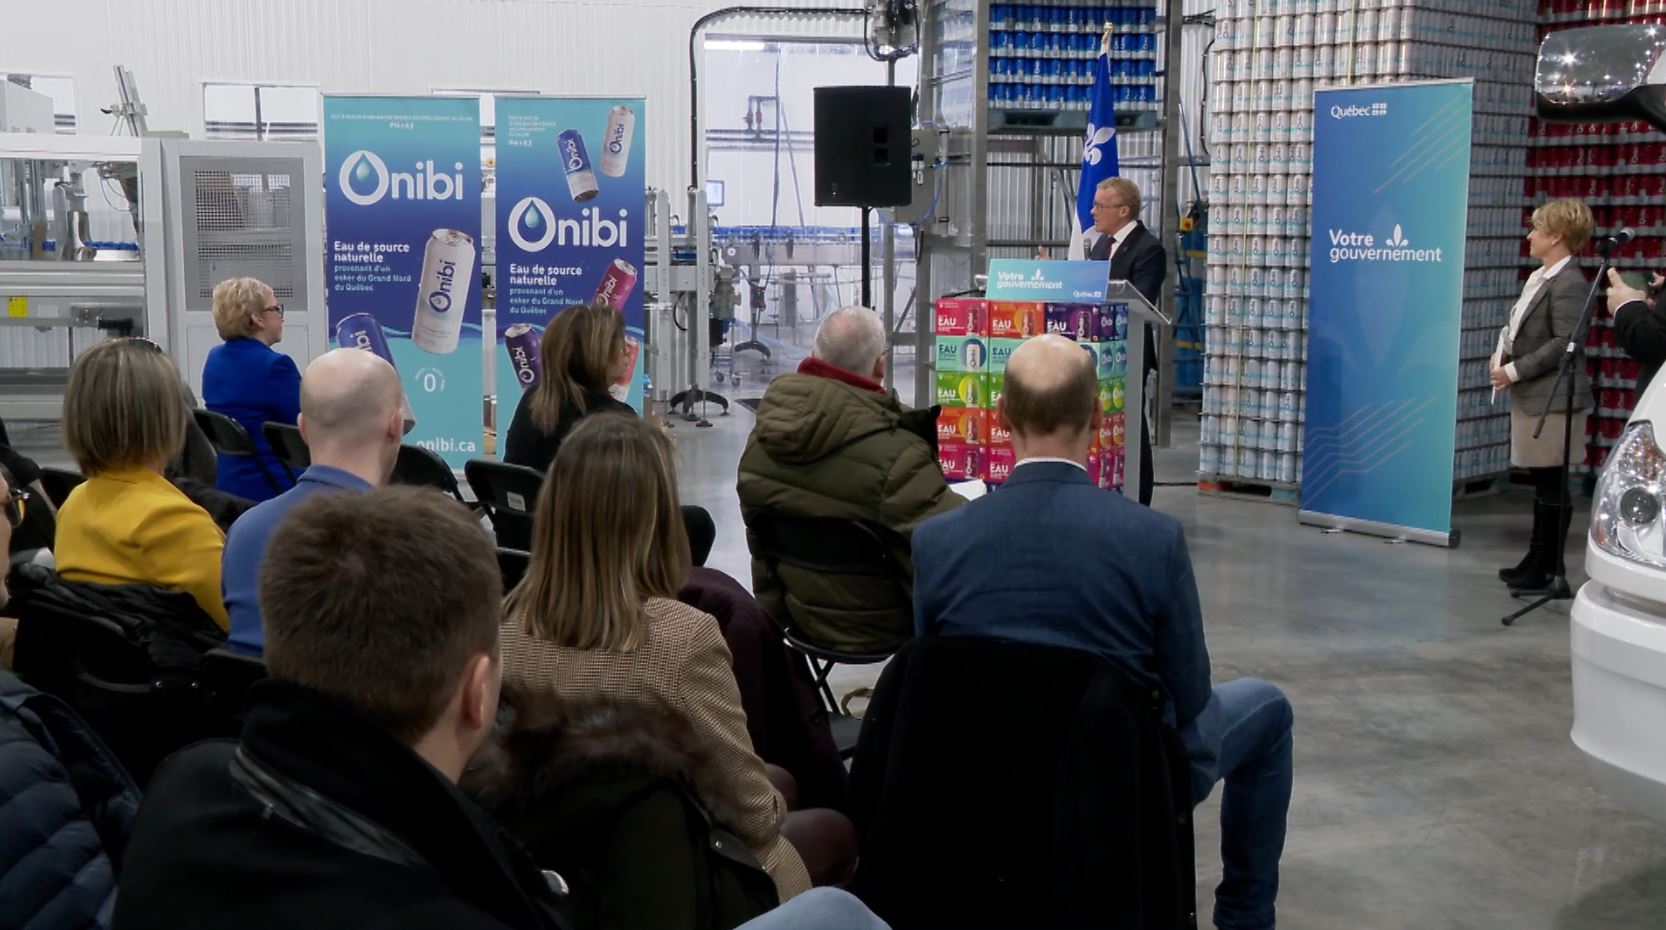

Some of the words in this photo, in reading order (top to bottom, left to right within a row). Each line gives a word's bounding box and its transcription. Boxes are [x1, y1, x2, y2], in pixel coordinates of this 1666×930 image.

[1331, 103, 1371, 119] Québec
[608, 123, 625, 154] Onibi
[564, 139, 583, 171] Onibi
[338, 150, 464, 206] Onibi
[508, 196, 628, 252] Onibi
[1329, 228, 1374, 246] Votre
[334, 241, 354, 252] Eau
[357, 241, 371, 252] de
[373, 243, 410, 252] source
[334, 252, 384, 263] naturelle
[1330, 247, 1442, 263] gouvernement
[334, 265, 372, 273] provenant
[510, 264, 530, 275] Eau
[532, 264, 546, 275] de
[548, 266, 582, 276] source
[510, 275, 557, 286] naturelle
[998, 271, 1024, 280] Votre
[428, 258, 456, 313] Onibi
[996, 280, 1062, 289] gouvernement
[510, 288, 546, 296] provenant
[938, 316, 956, 326] EAU
[992, 320, 1012, 329] EAU
[1047, 321, 1067, 331] EAU
[938, 344, 957, 354] EAU
[992, 348, 1012, 356] EAU
[513, 346, 534, 384] Onibi
[938, 388, 956, 398] EAU
[938, 424, 956, 434] EAU
[991, 428, 1010, 438] EAU
[416, 438, 476, 452] onibi.ca
[990, 462, 1009, 473] EAU
